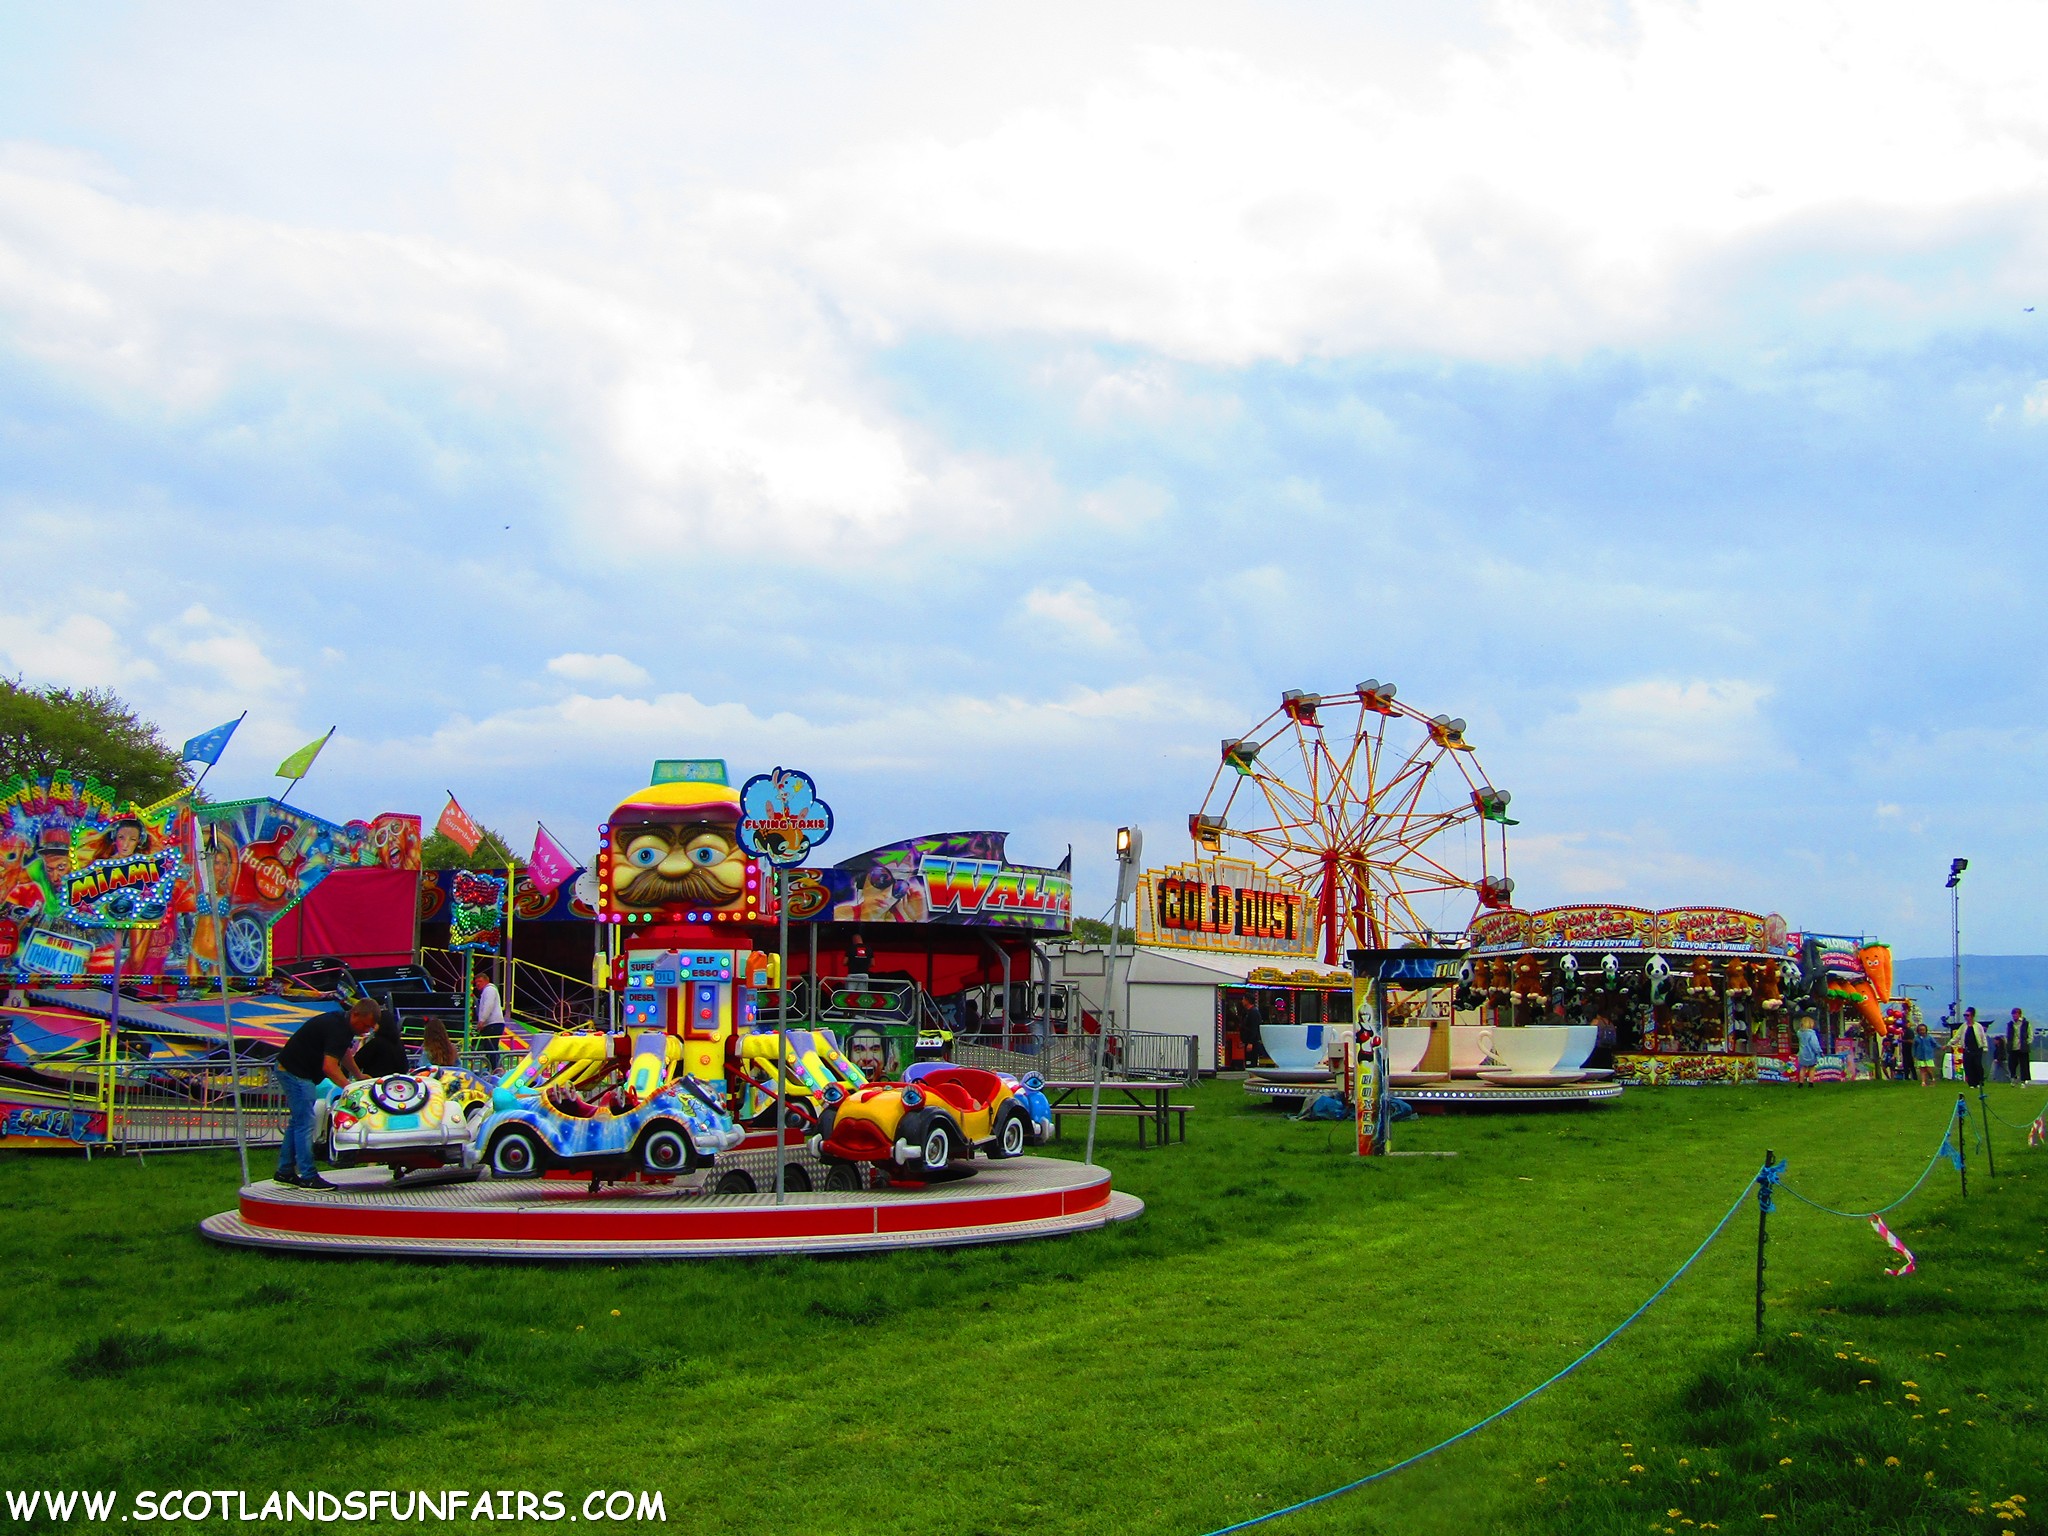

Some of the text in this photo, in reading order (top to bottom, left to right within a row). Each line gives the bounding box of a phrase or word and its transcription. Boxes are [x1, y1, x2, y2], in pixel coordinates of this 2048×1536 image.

[744, 819, 826, 830] FLYING TAXIS
[1162, 877, 1302, 941] GOLD DUST
[1554, 911, 1597, 930] FUN
[1679, 914, 1715, 930] FUN
[1569, 919, 1635, 939] GAMES
[1691, 921, 1748, 941] GAMES
[1545, 940, 1562, 948] IT'S
[1563, 940, 1570, 948] A
[1570, 940, 1594, 948] PRIZE
[1722, 943, 1752, 952] WINNER
[1821, 937, 1855, 951] OLOURS
[696, 956, 715, 965] ELF
[655, 973, 672, 982] OIL
[692, 969, 719, 977] ESSO
[629, 993, 656, 1002] DIESEL
